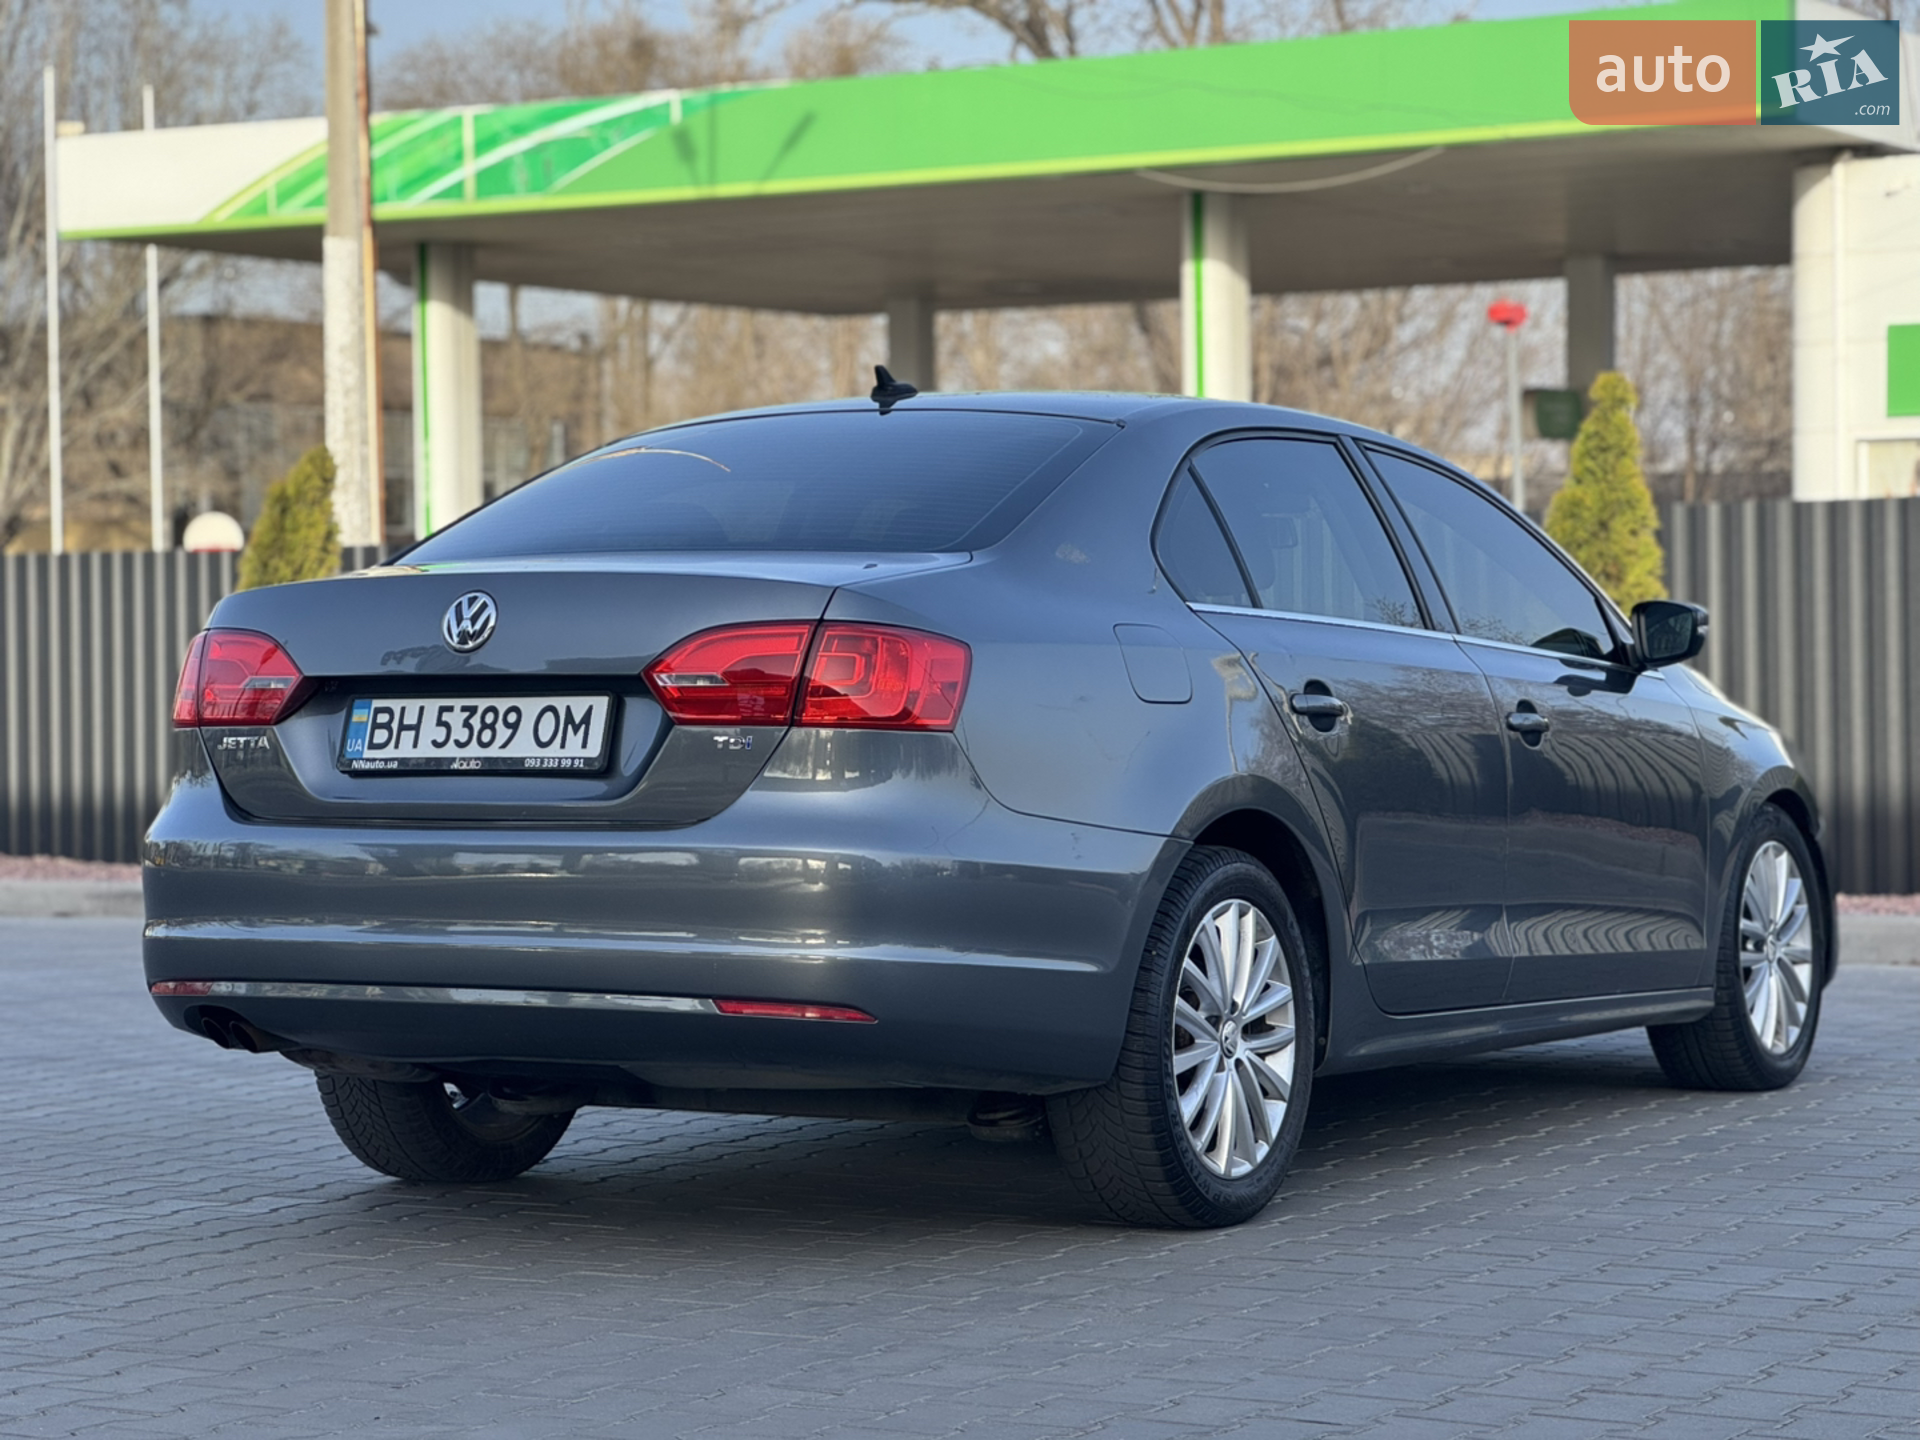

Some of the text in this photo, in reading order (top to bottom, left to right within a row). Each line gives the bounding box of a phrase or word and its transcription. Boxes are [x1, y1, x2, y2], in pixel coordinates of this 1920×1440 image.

[367, 703, 595, 751] BH 5389 OM
[217, 735, 270, 750] JETTA
[346, 738, 363, 752] UA
[713, 735, 753, 750] TDI
[351, 759, 398, 769] NNauto.ua
[524, 758, 585, 767] 093 333 99 91
